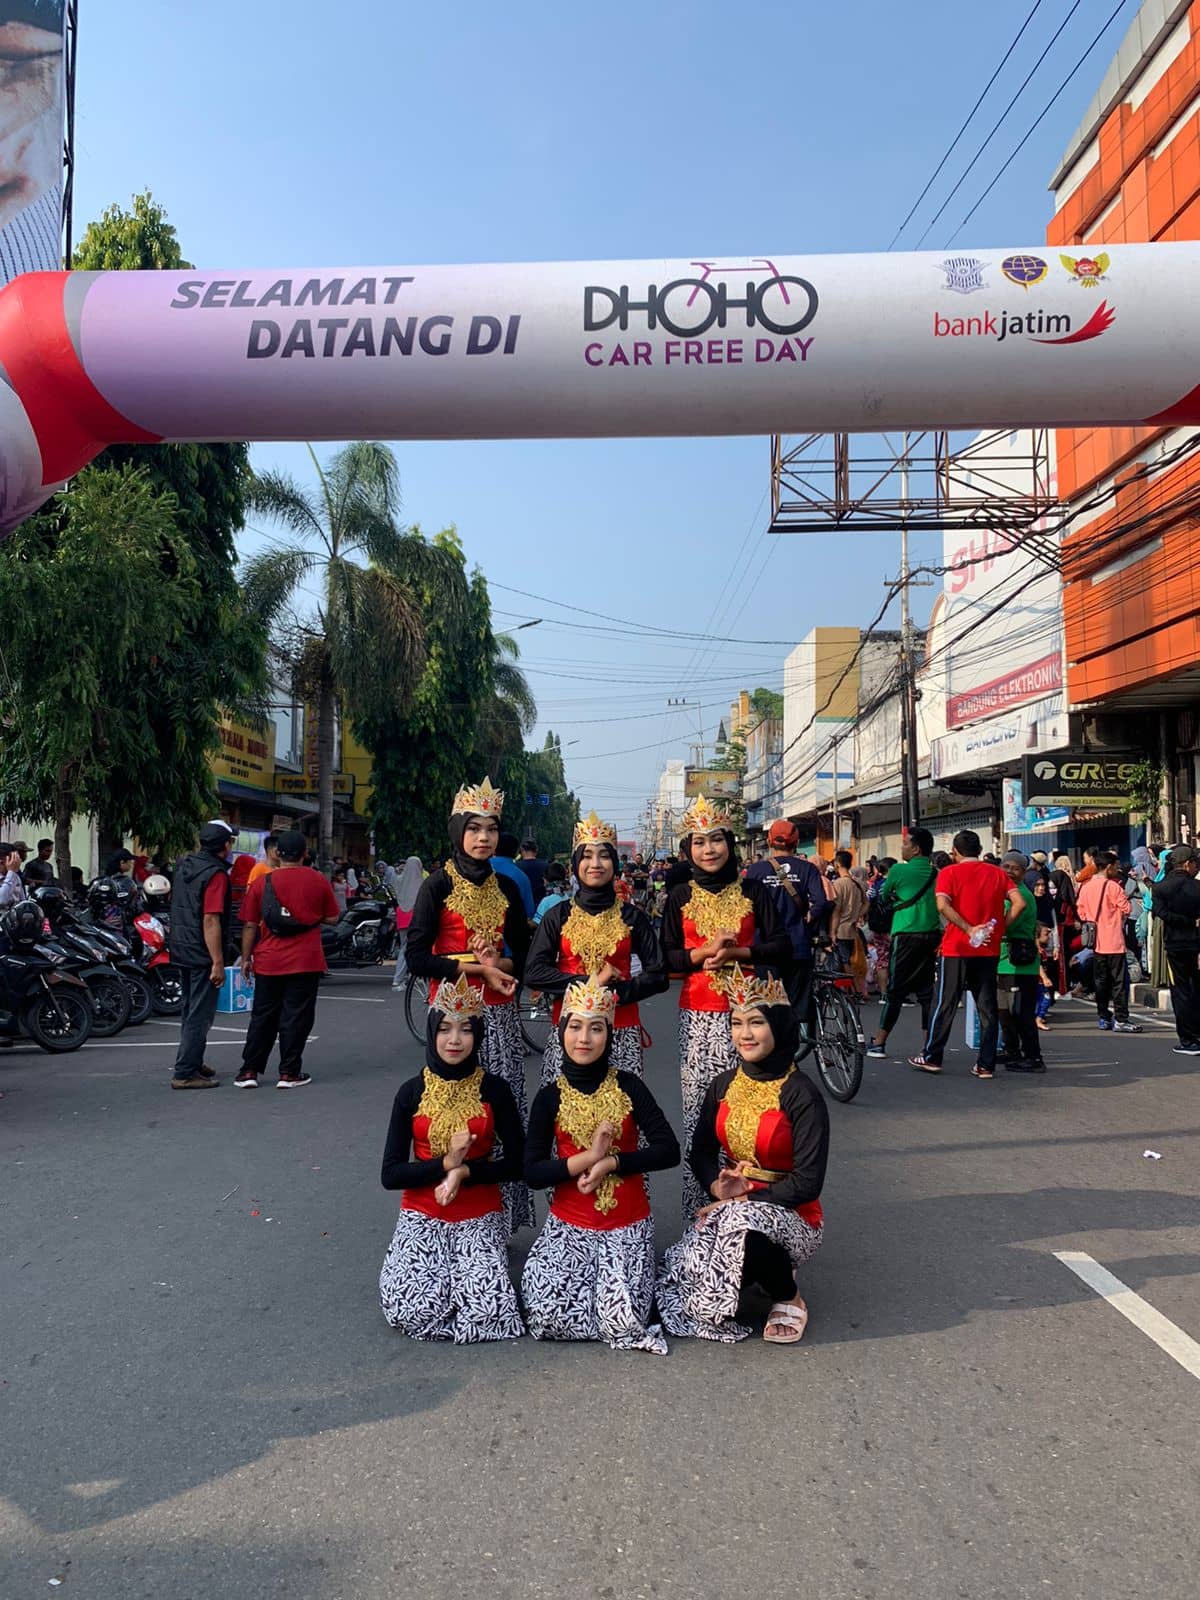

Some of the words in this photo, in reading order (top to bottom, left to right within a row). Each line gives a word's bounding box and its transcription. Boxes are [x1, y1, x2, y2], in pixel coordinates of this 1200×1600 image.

[170, 276, 415, 309] SELAMAT
[583, 275, 819, 338] DHOHO
[246, 315, 455, 359] DATANG
[465, 315, 521, 356] DI
[584, 342, 652, 366] CAR
[665, 339, 743, 365] FREE
[755, 337, 815, 362] DAY
[956, 687, 997, 718] BANDUNG
[998, 660, 1061, 703] ELEKTRONIK
[1060, 781, 1088, 790] Pelopor
[1090, 781, 1102, 789] AC
